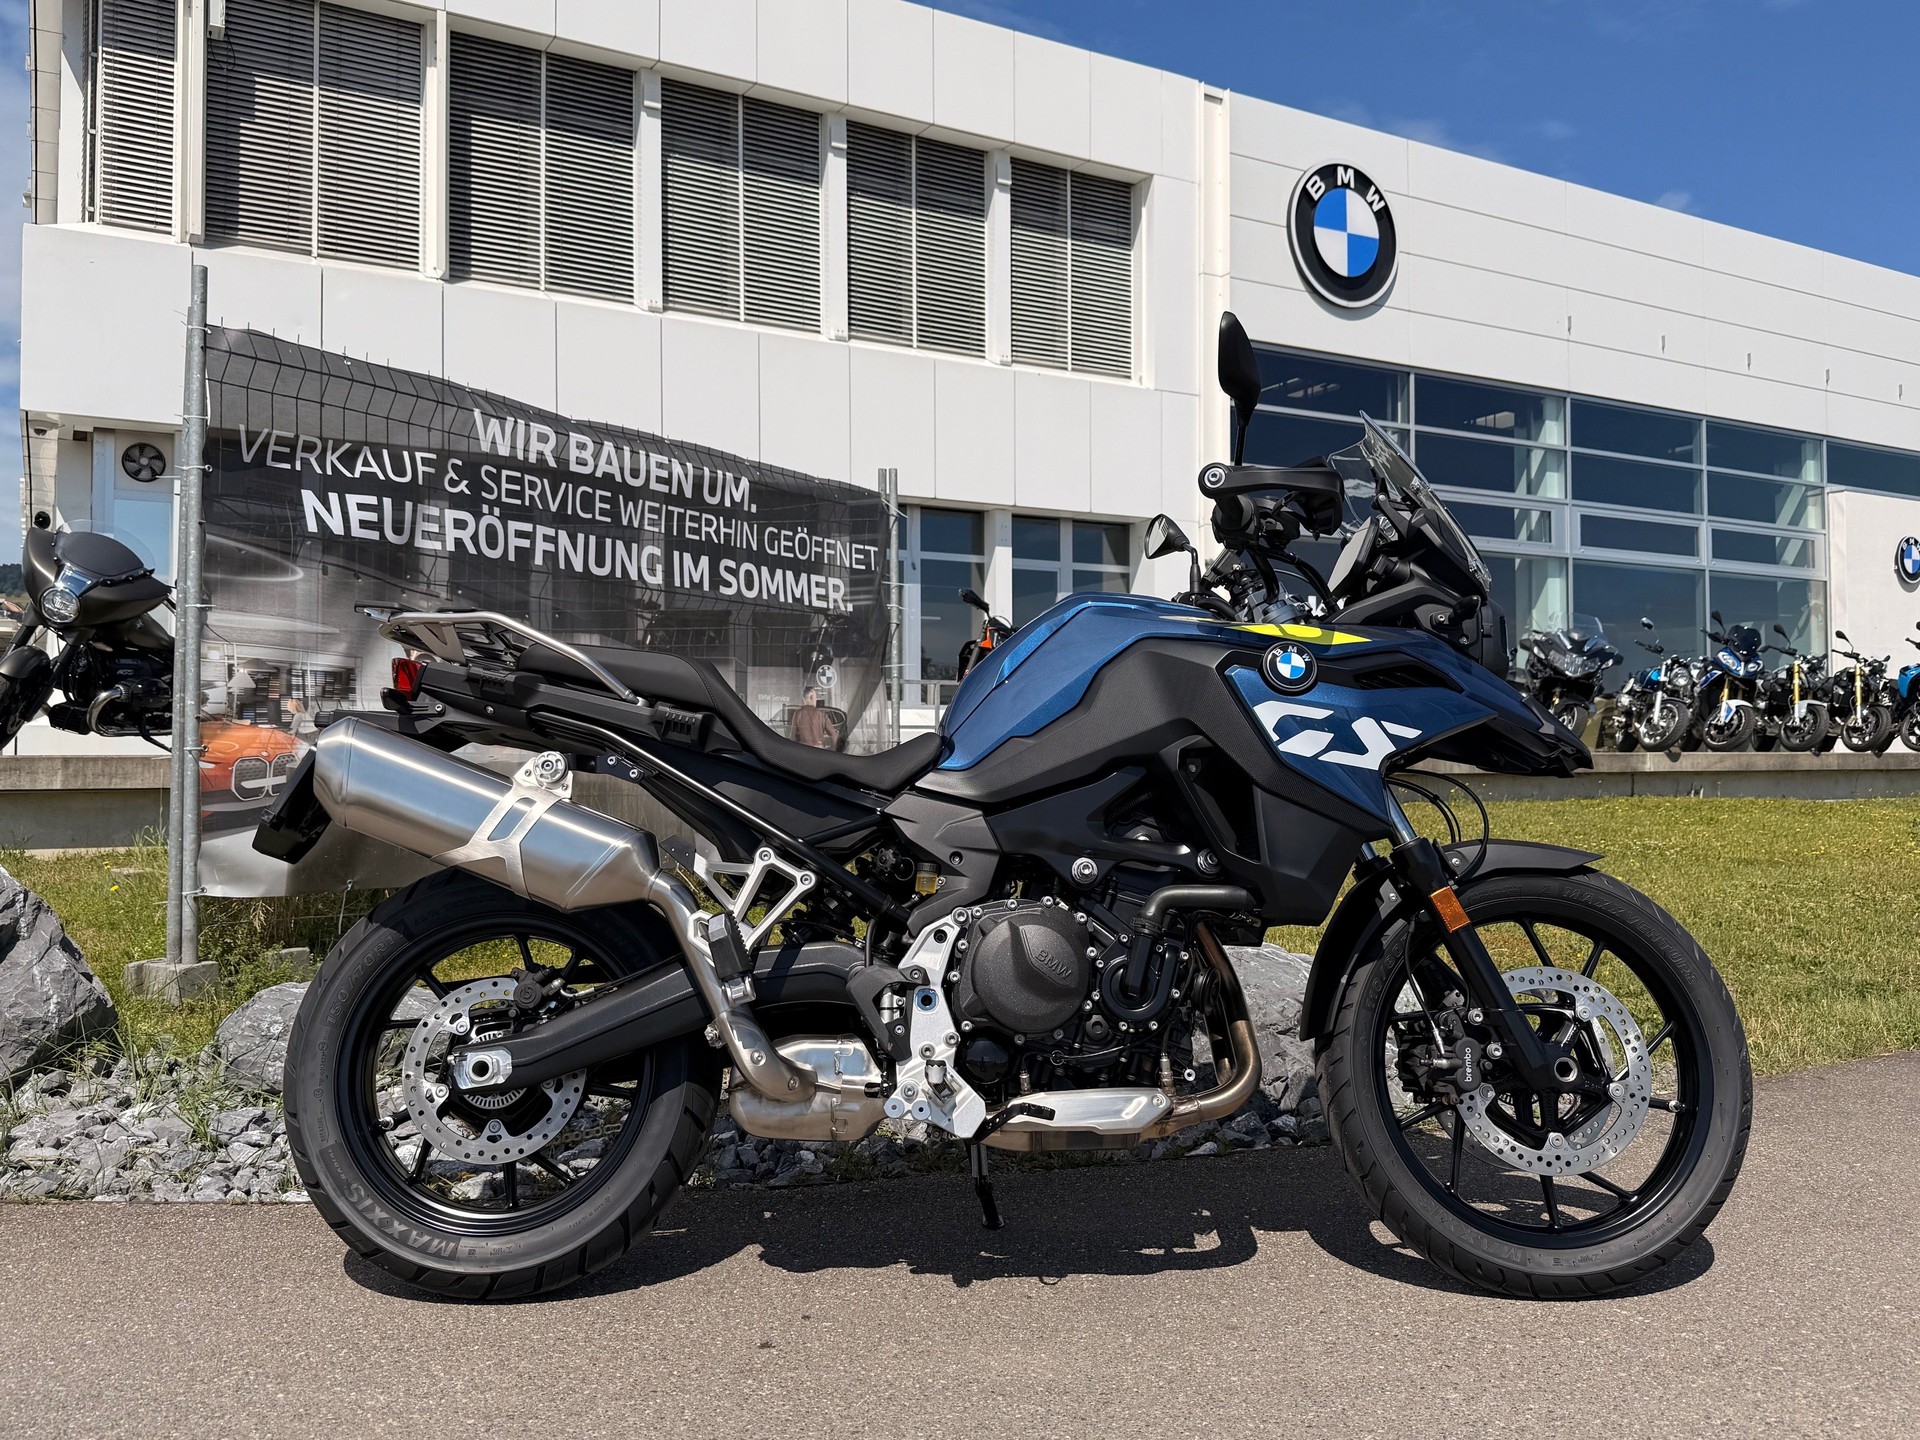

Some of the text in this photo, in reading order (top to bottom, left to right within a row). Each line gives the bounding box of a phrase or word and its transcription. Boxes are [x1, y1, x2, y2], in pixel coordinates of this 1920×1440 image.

[1305, 165, 1386, 212] BMW
[238, 424, 438, 486] VERKAUF
[443, 457, 472, 495] &
[481, 464, 612, 523] SERVICE
[618, 494, 758, 551] WEITERHIN
[473, 408, 757, 513] WIR BAUEN UM.
[300, 489, 662, 585] NEUERÖFFNUNG
[673, 550, 710, 592] IM
[719, 559, 854, 613] SOMMER.
[1273, 645, 1311, 662] BMW
[1253, 700, 1423, 770] GS
[1035, 950, 1072, 980] BMW
[1464, 1047, 1472, 1082] brembo
[344, 1182, 456, 1257] MAXXIS
